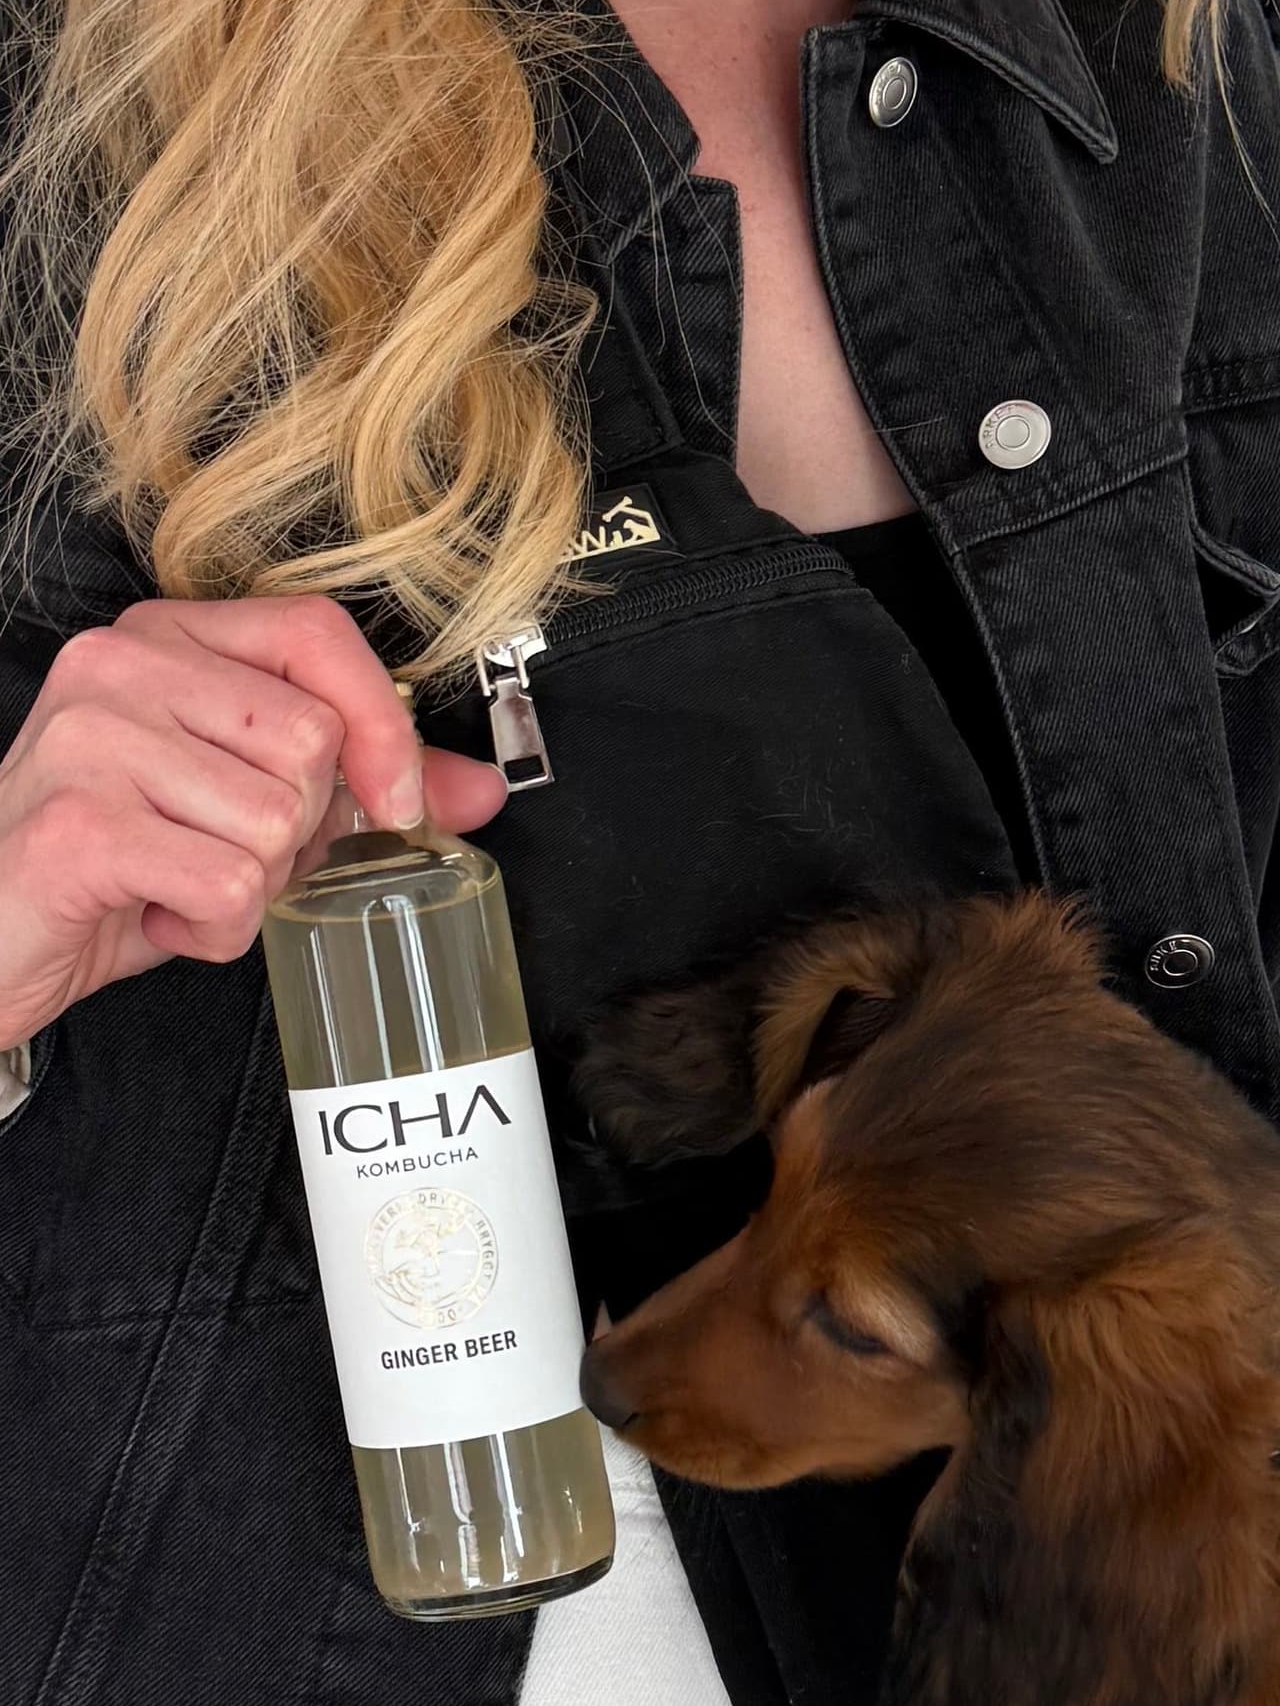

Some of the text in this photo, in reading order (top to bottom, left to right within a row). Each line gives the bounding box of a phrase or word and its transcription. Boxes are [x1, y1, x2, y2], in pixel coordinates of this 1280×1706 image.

[318, 1084, 512, 1156] ICHA
[356, 1146, 479, 1179] KOMBUCHA
[380, 1329, 518, 1370] GINGER BEER
